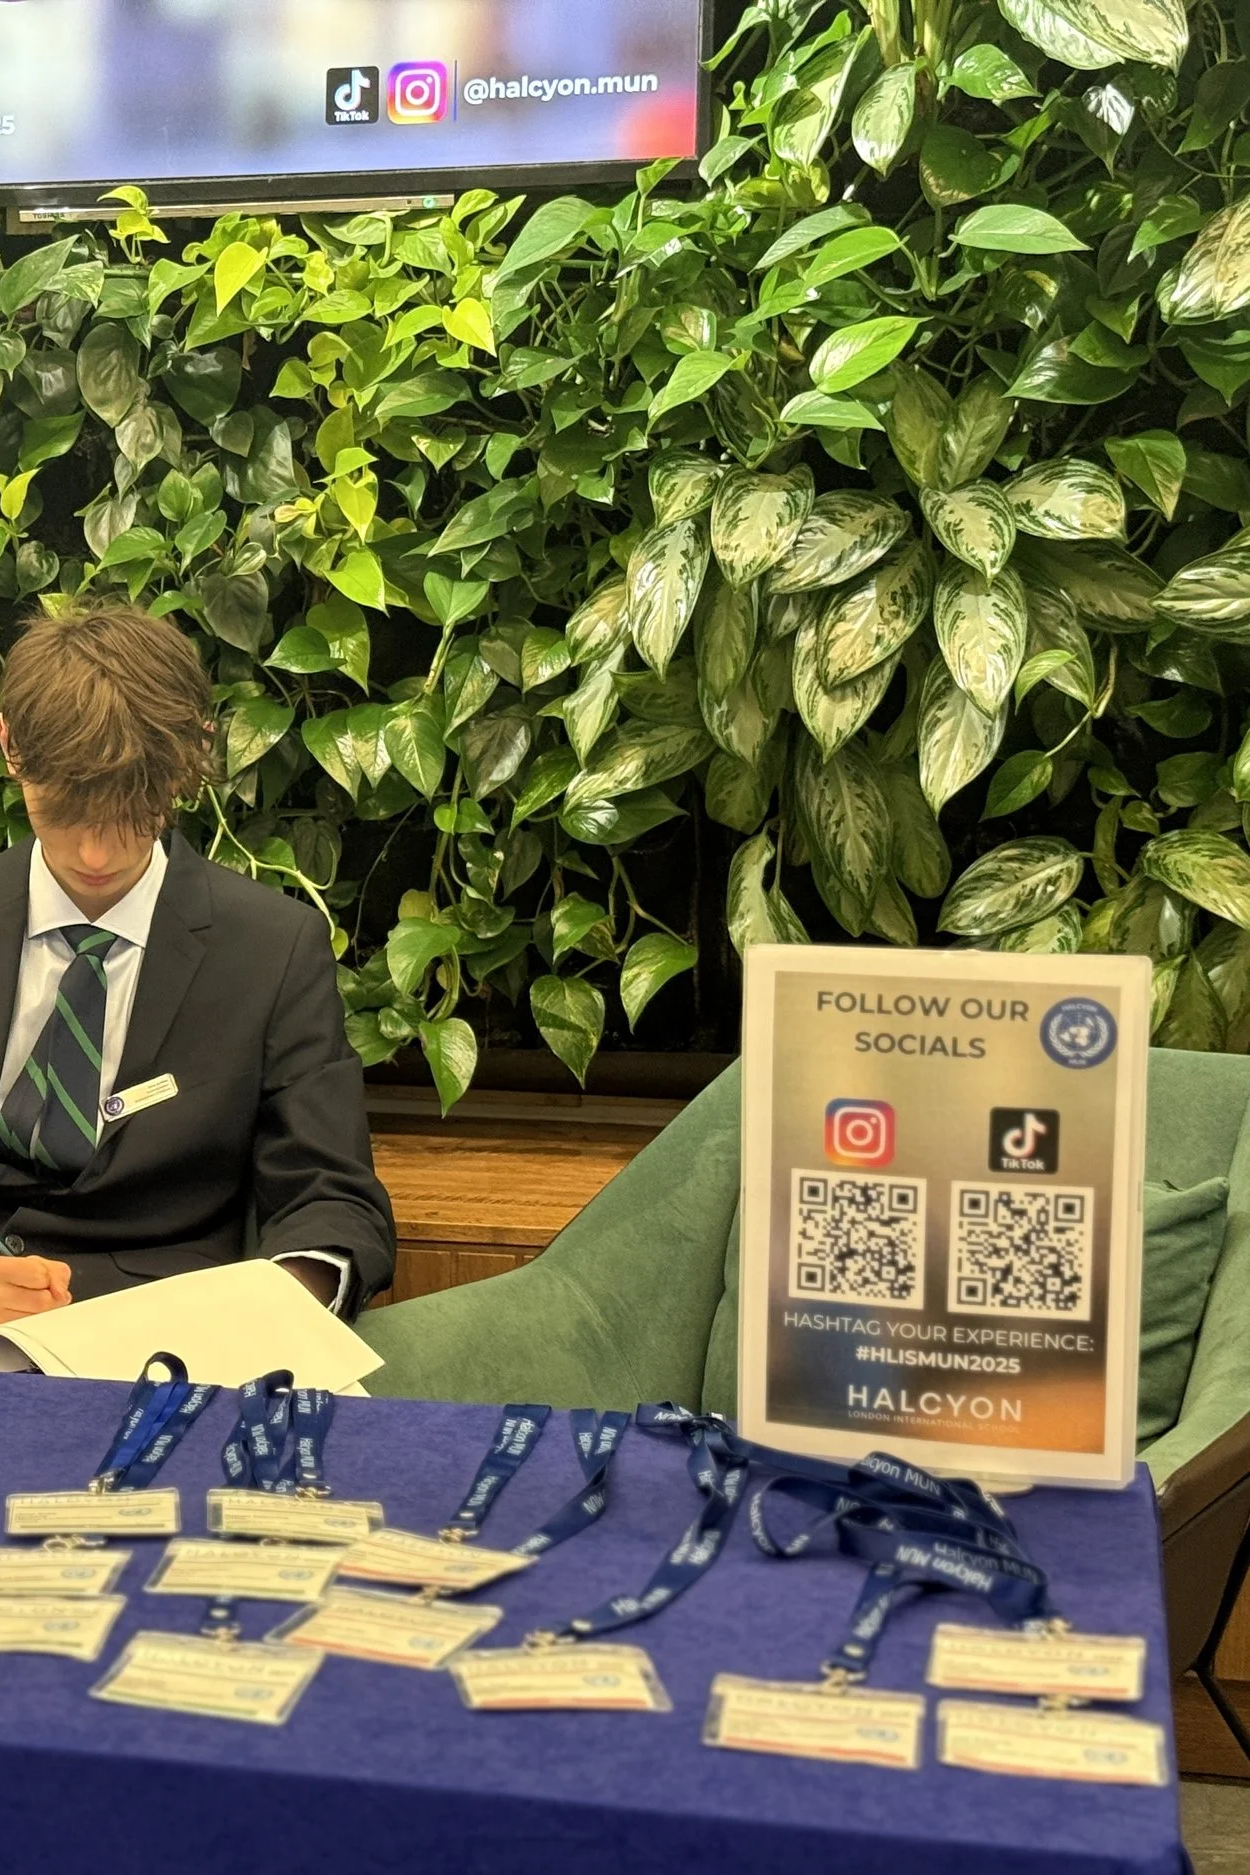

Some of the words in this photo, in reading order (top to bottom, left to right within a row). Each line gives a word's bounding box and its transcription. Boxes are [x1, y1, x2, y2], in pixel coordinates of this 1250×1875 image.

[462, 73, 658, 105] @halcyon.mun
[334, 110, 370, 123] TikTok
[816, 990, 950, 1018] FOLLOW
[960, 996, 1029, 1023] OUR
[854, 1032, 986, 1059] SOCIALS
[1000, 1157, 1046, 1171] TikTok
[783, 1312, 881, 1338] HASHTAG
[886, 1321, 947, 1343] YOUR
[953, 1328, 1095, 1352] EXPERIENCE:
[855, 1345, 1021, 1374] #HLISMUN2025
[848, 1384, 1022, 1422] HALCYON
[848, 1410, 890, 1422] LONDON
[893, 1415, 974, 1430] INTERNATIONAL
[904, 1468, 942, 1497] MUN
[895, 1545, 931, 1568] MUN
[931, 1556, 993, 1593] Halcyon
